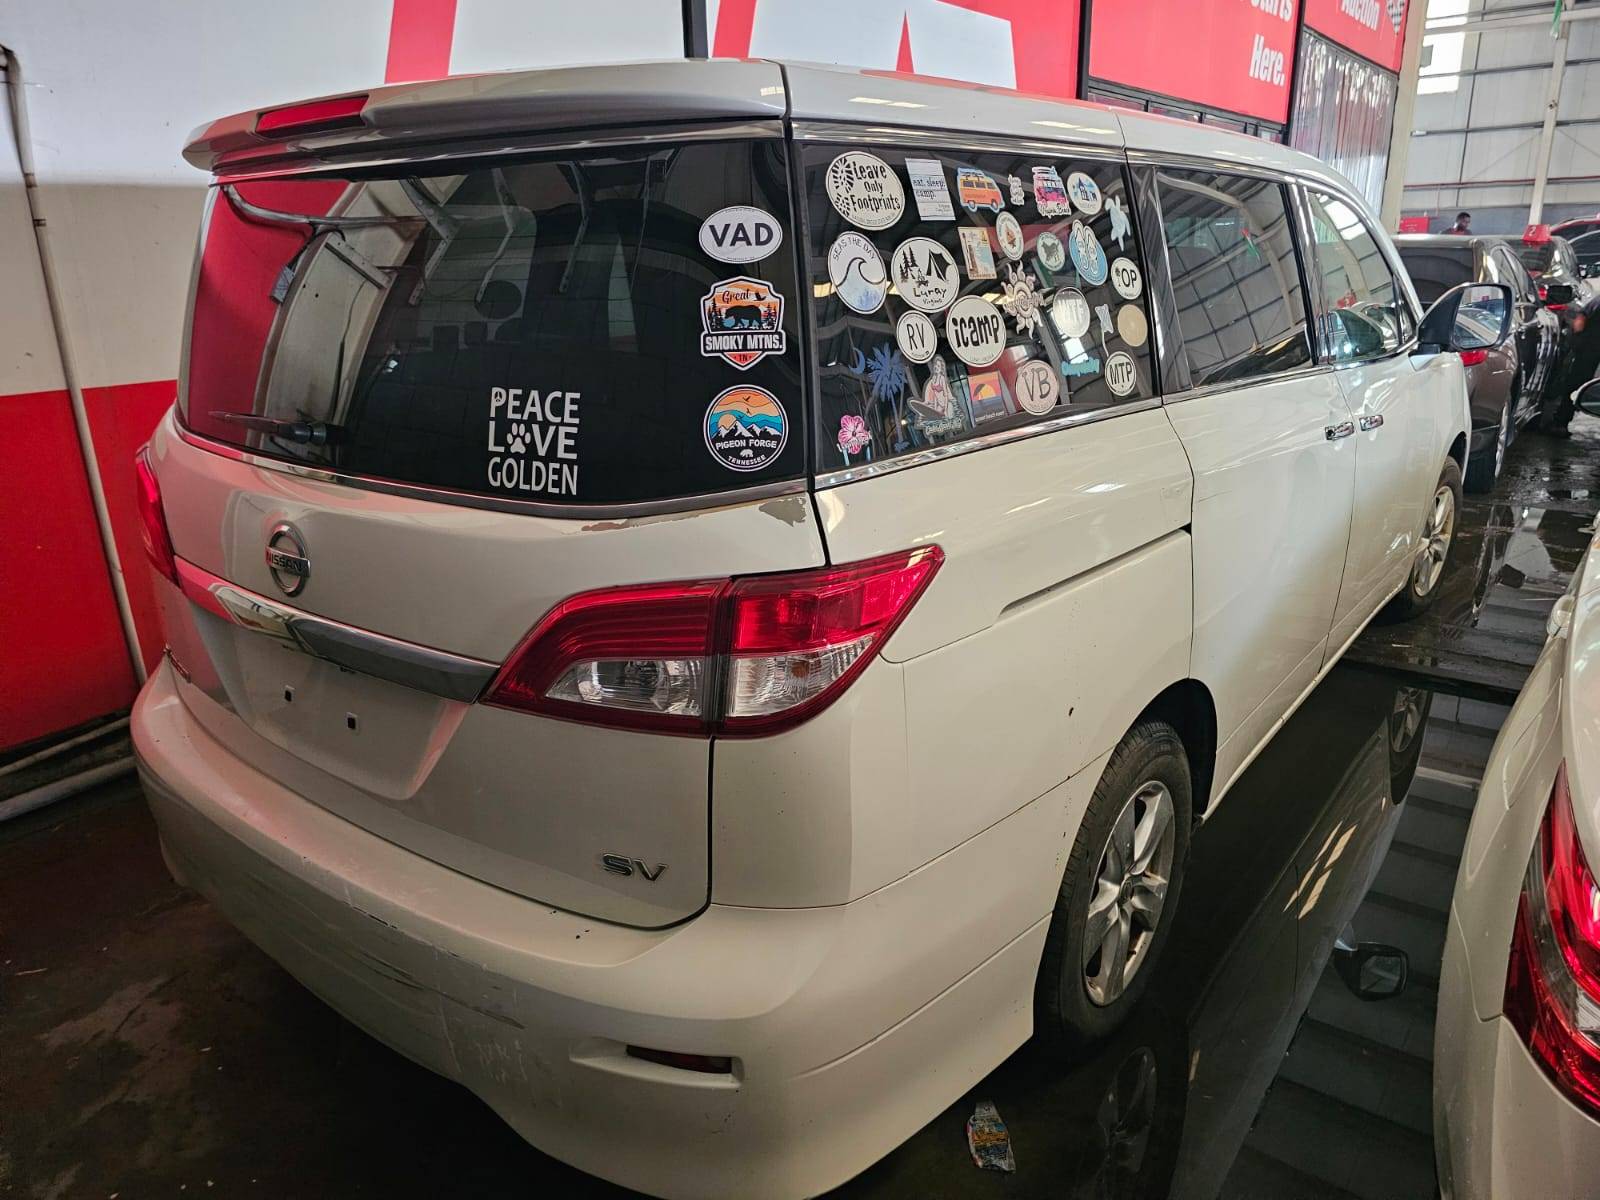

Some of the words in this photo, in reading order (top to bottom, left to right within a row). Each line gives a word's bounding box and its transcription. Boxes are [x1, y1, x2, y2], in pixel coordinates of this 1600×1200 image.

[1249, 33, 1285, 87] Here.
[852, 161, 887, 180] Leave
[864, 180, 882, 194] Only
[850, 193, 901, 213] Footprints
[709, 222, 774, 247] VAD
[832, 239, 848, 260] SEAS
[847, 236, 862, 247] THE
[1121, 268, 1137, 288] OP
[722, 288, 750, 304] Great
[705, 335, 744, 351] SMOKY
[746, 334, 783, 350] MTNS.
[906, 323, 926, 350] RV
[1022, 367, 1051, 402] VB
[1109, 362, 1133, 385] MTP
[489, 387, 581, 424] PEACE
[715, 439, 746, 450] PIGEON
[749, 438, 778, 449] FORGE
[728, 455, 766, 466] TENNESSEE
[487, 456, 578, 495] GOLDEN
[265, 550, 303, 574] NISSAN
[602, 853, 668, 881] SV
